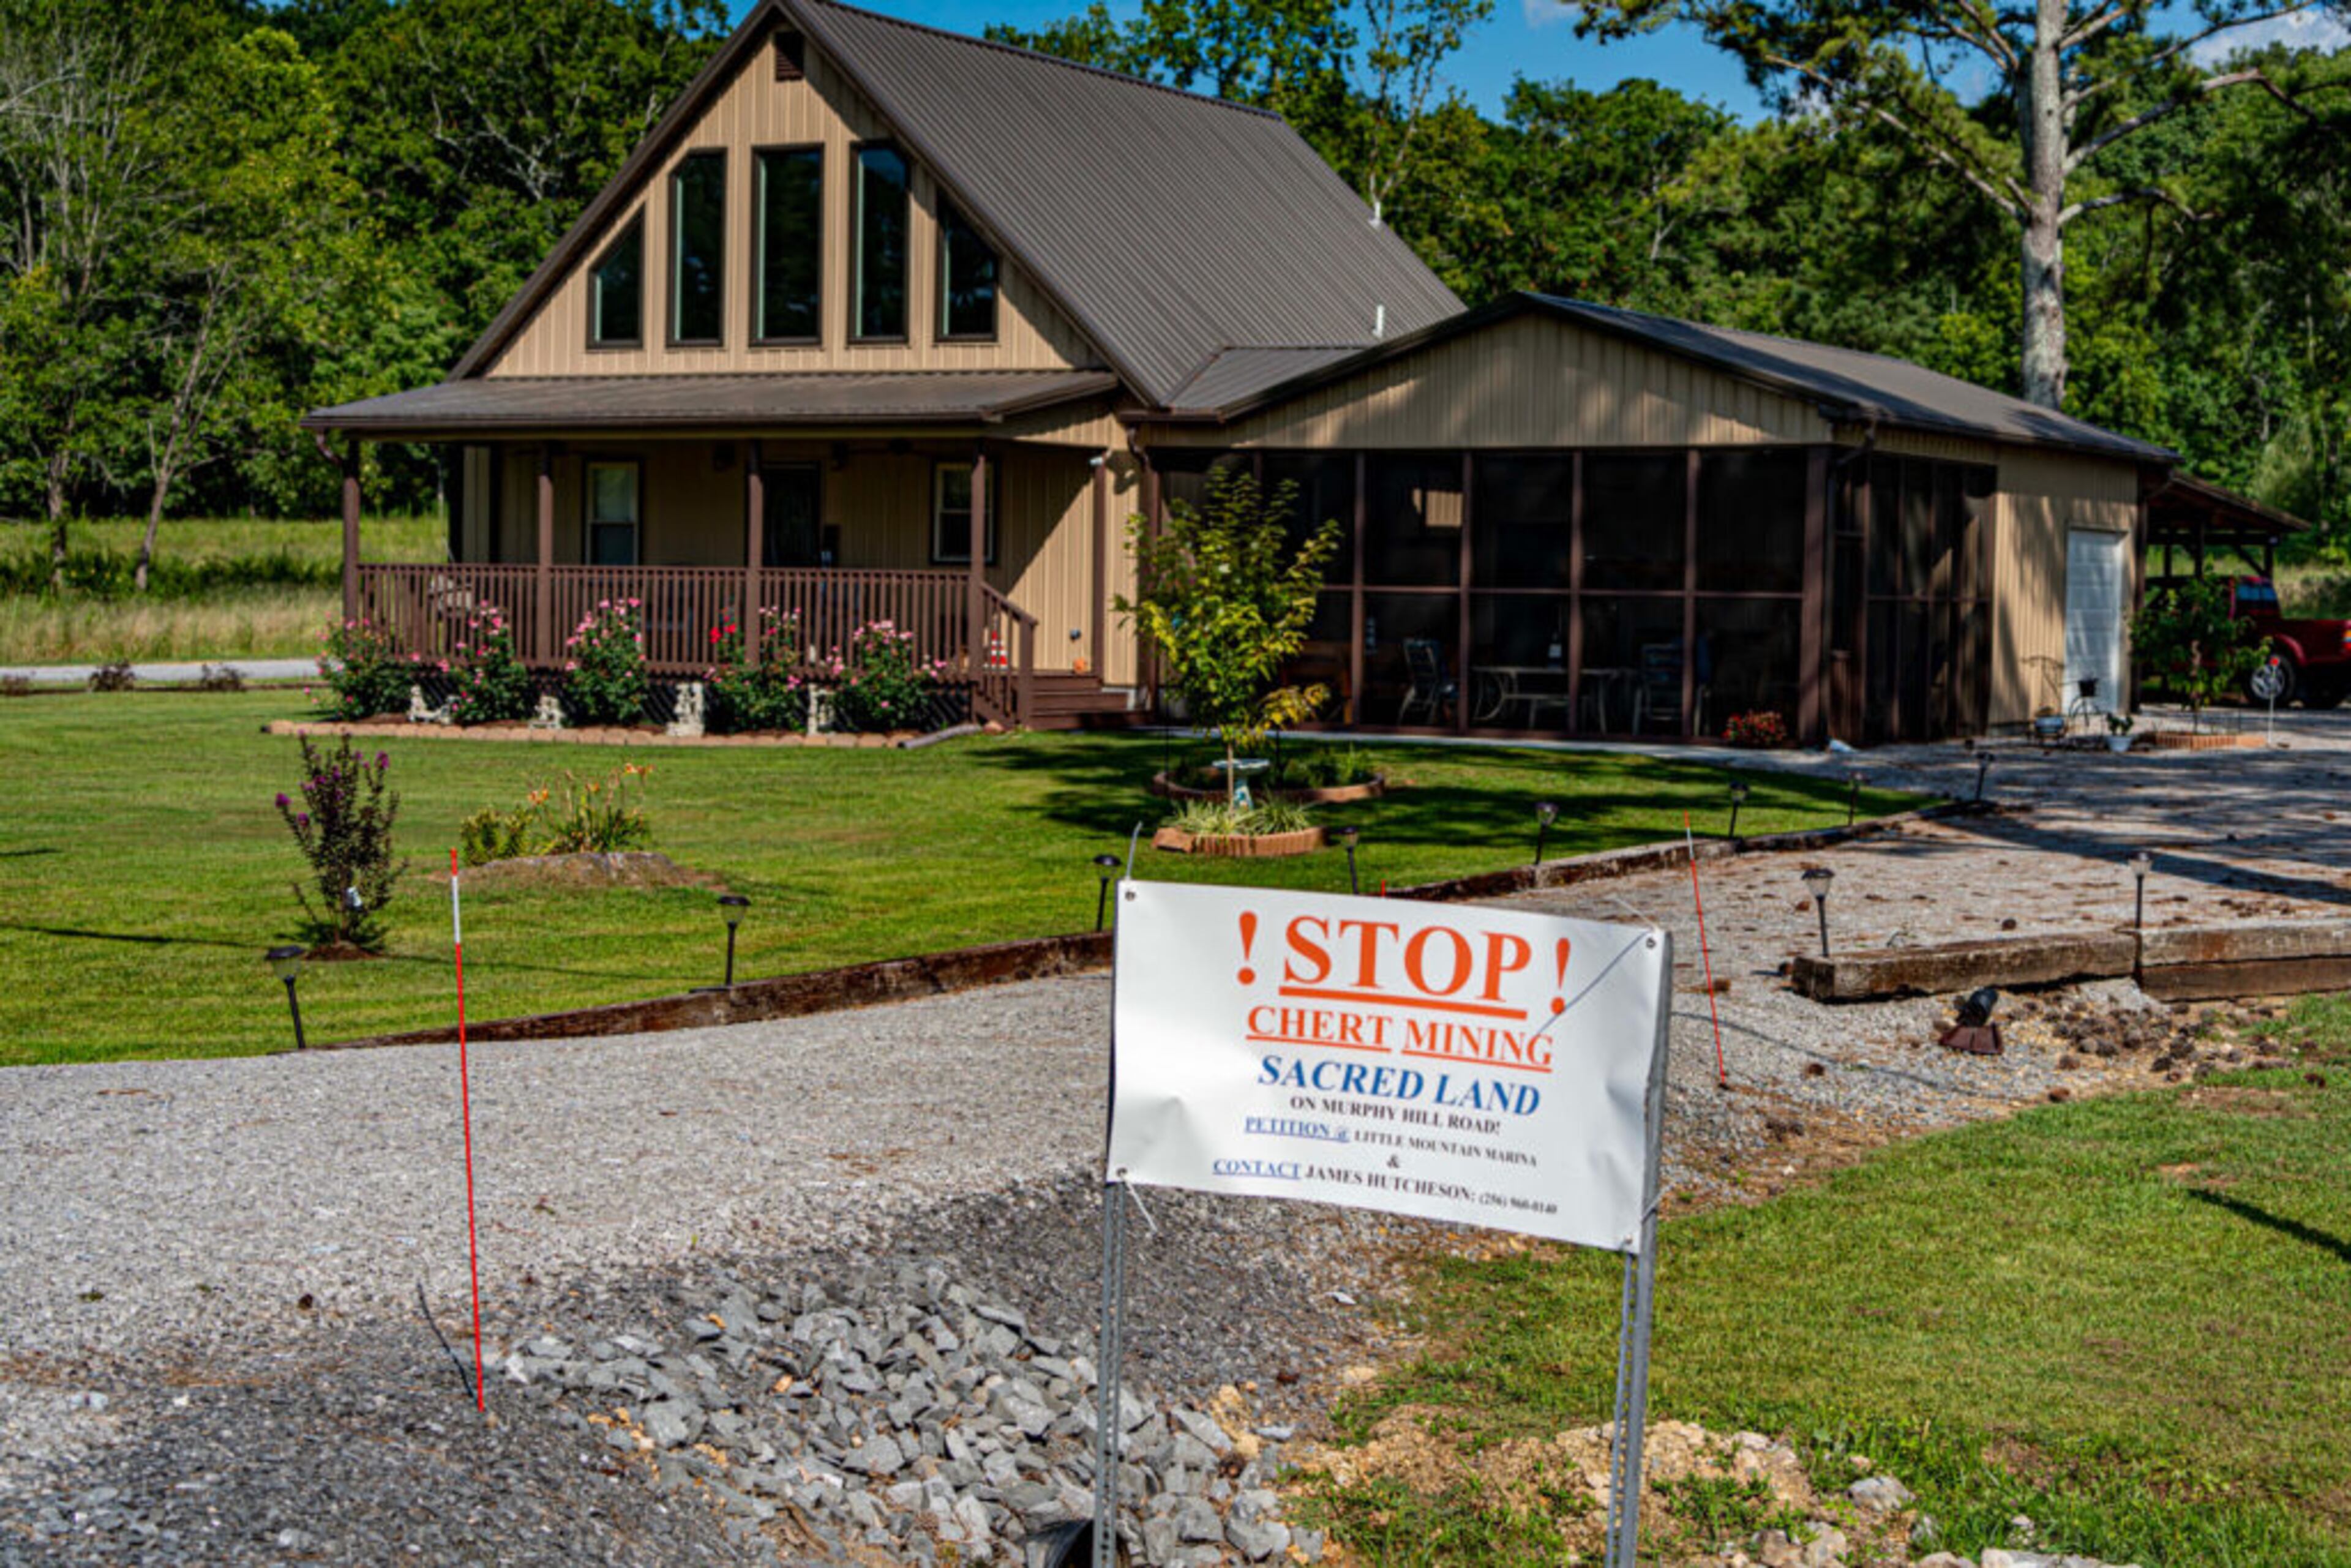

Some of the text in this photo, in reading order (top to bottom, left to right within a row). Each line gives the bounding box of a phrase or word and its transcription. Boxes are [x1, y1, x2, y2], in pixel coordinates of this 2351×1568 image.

[1283, 915, 1532, 1003] STOP
[1247, 1005, 1553, 1066] CHERT MINING
[1257, 1054, 1541, 1116] SACRED LAND
[1289, 1096, 1501, 1135] ON MURPHY HILL ROAD!
[1245, 1117, 1330, 1137] PETITION
[1354, 1130, 1403, 1147] LITTLE
[1408, 1136, 1482, 1158] MOUNTAIN
[1485, 1147, 1537, 1167] MARINA
[1386, 1154, 1401, 1169] &
[1213, 1158, 1302, 1177] CONTACT
[1305, 1164, 1363, 1185] JAMES
